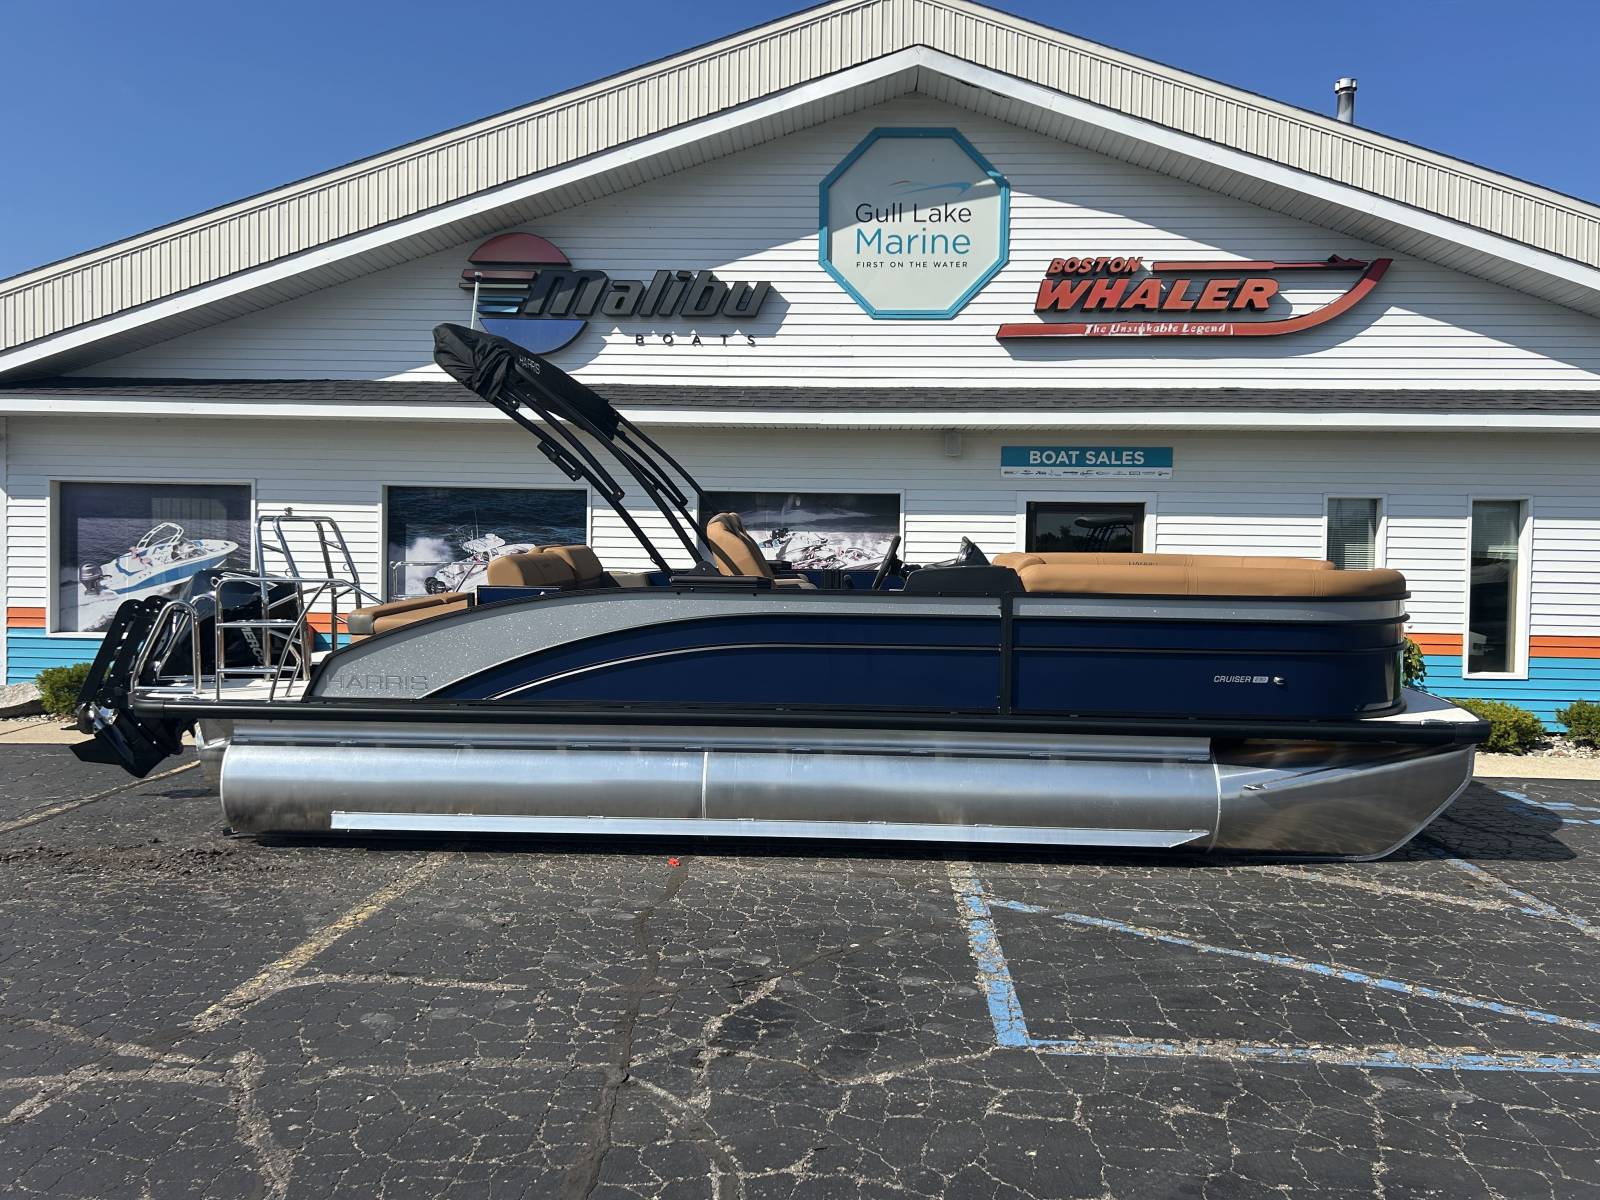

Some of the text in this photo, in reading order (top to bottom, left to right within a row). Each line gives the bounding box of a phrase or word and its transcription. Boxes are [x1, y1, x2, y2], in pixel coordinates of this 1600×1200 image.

[855, 202, 972, 223] Gull Lake
[856, 227, 971, 255] Marine
[1048, 257, 1142, 274] BOSTON
[522, 269, 772, 318] Malibu
[1035, 278, 1280, 311] WHALER
[1085, 324, 1106, 336] The
[1182, 323, 1226, 335] Legend
[636, 334, 757, 346] BOATS
[1029, 450, 1145, 465] BOAT SALES
[326, 674, 428, 690] HARRIS
[1213, 675, 1252, 683] CRUISER
